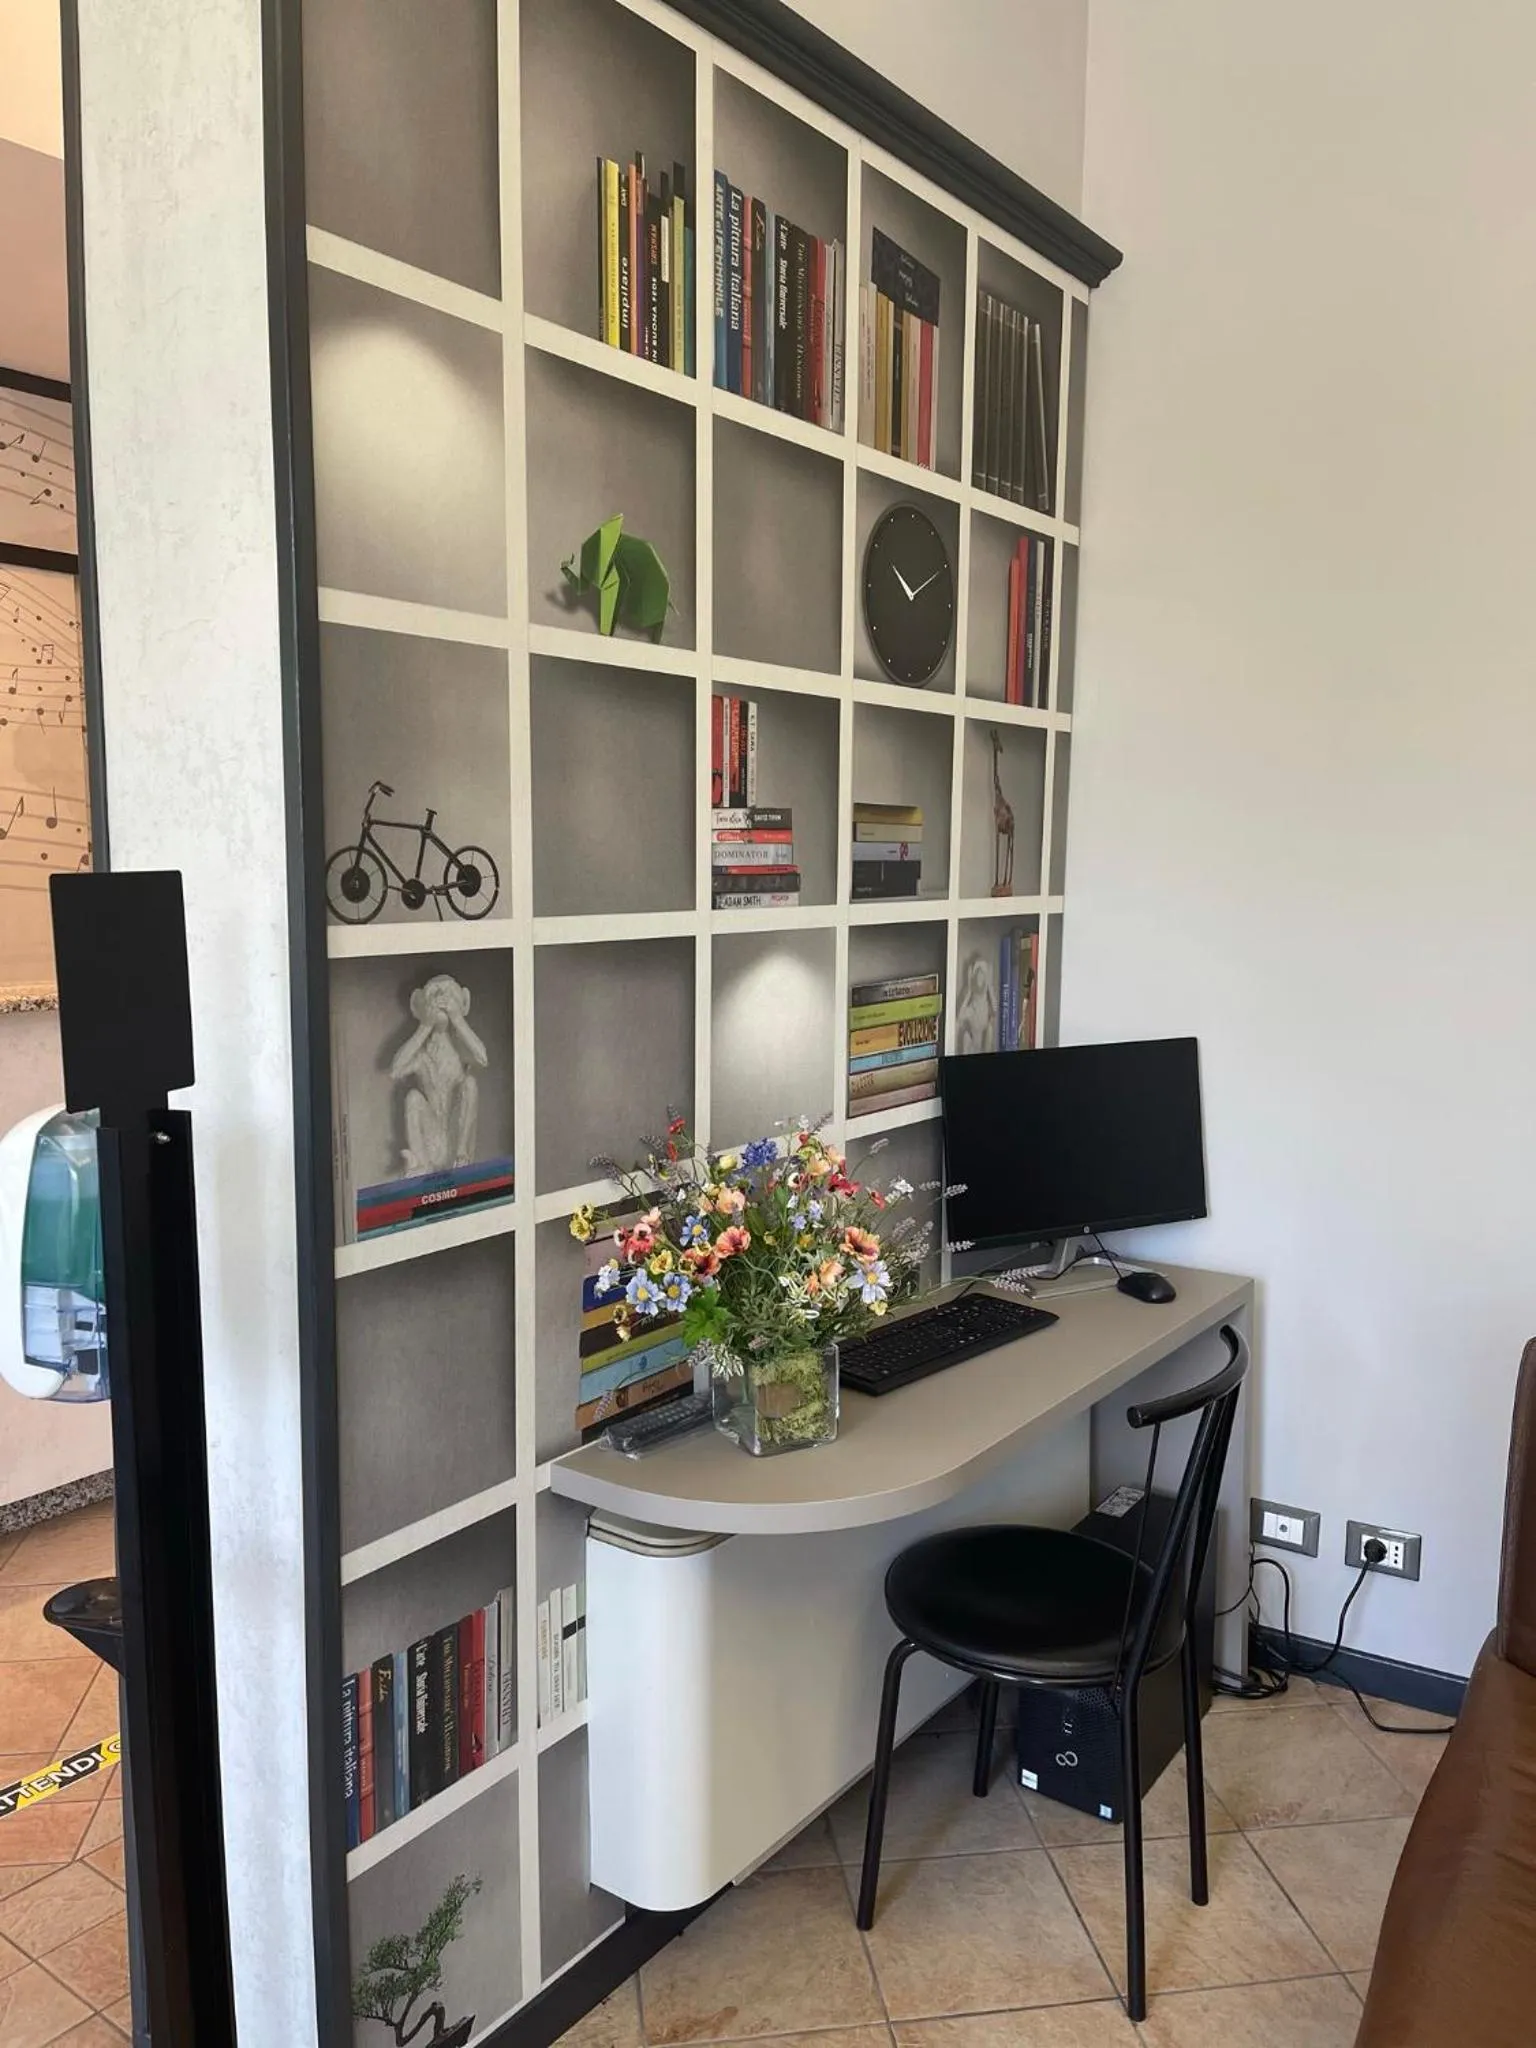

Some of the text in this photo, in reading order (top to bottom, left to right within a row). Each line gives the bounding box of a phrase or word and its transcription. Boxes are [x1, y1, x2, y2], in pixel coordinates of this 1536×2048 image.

[728, 190, 742, 330] La pittura italiana
[620, 256, 629, 329] impilare
[714, 849, 769, 860] DOMINATOR
[421, 1188, 458, 1205] COSMO
[344, 1745, 358, 1799] italiana
